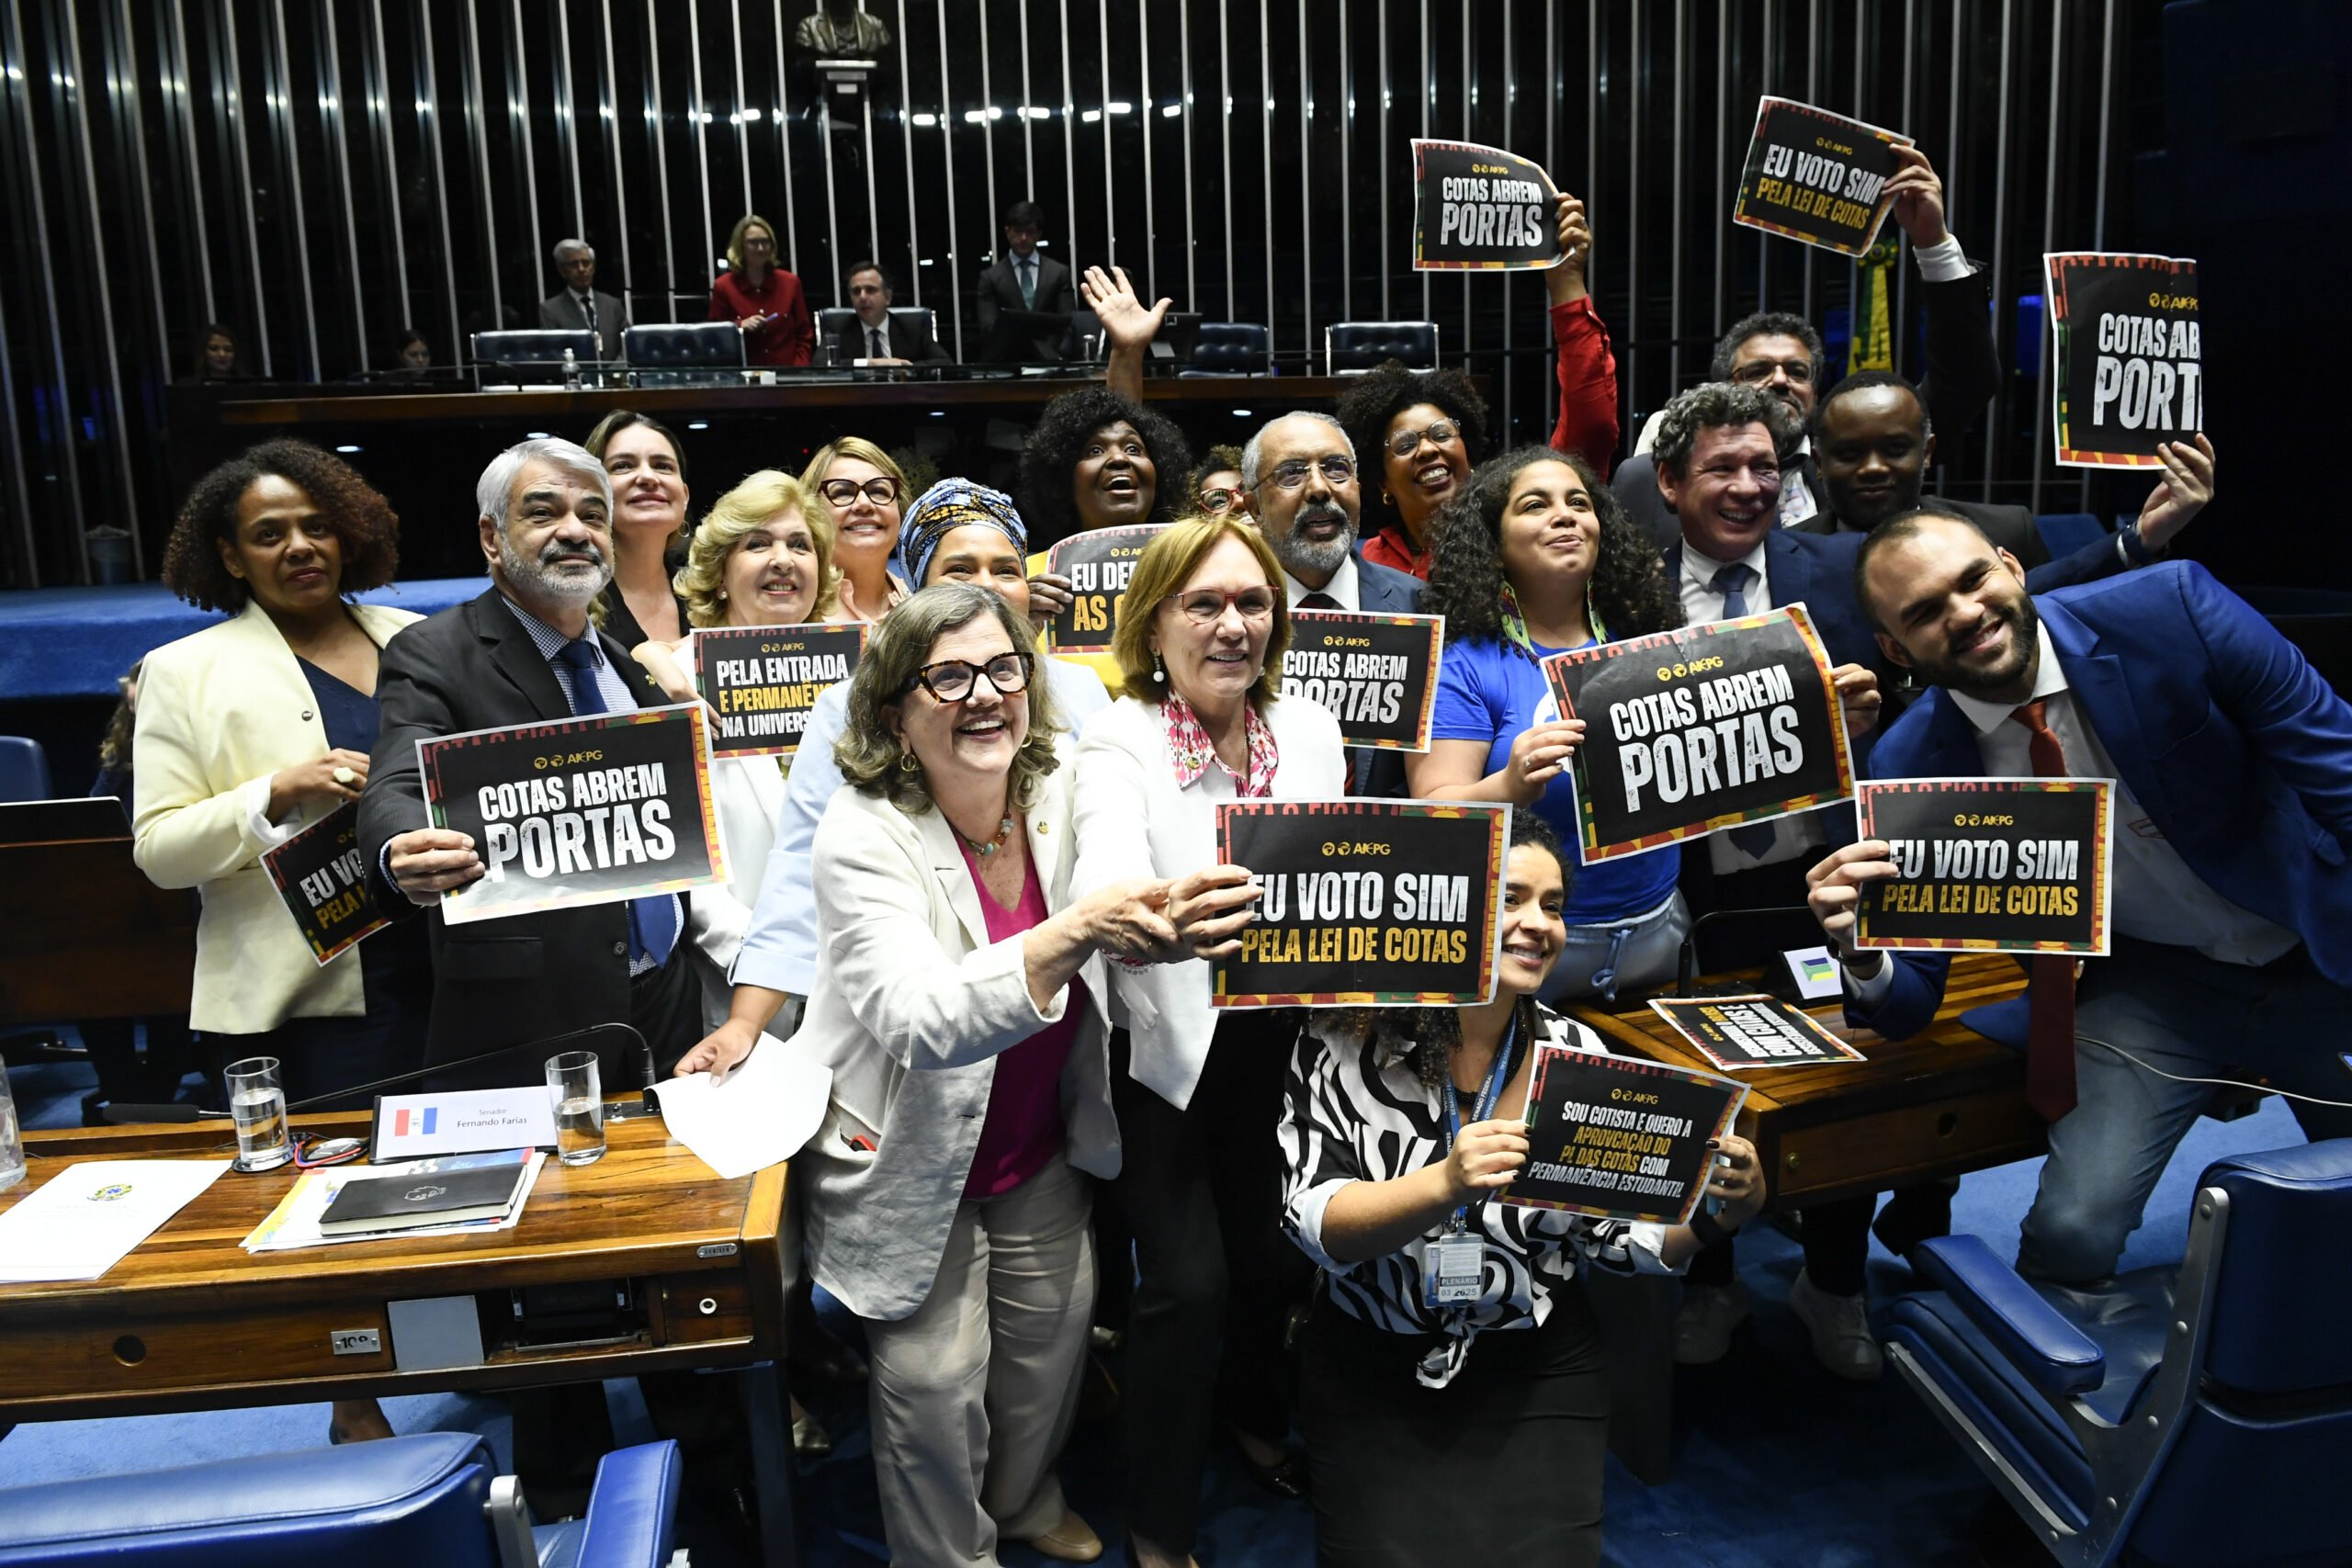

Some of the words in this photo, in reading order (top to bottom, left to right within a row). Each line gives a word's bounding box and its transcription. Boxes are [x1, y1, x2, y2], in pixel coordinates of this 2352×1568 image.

[1442, 176, 1488, 202] COTAS
[1492, 178, 1544, 203] ABREM
[1762, 144, 1793, 178] EU
[1794, 151, 1846, 193] VOTO
[1844, 168, 1886, 205] SIM
[1756, 177, 1792, 207] PELA
[1792, 186, 1815, 213] LEI
[1813, 192, 1834, 219] DE
[1831, 199, 1871, 230] COTAS
[1440, 203, 1544, 247] PORTAS
[2098, 312, 2166, 357] COTAS
[2093, 355, 2203, 431] PORT
[1071, 562, 1097, 592] EU
[1073, 594, 1108, 632] AS
[716, 658, 763, 687] PELA
[765, 653, 849, 683] ENTRADA
[1283, 650, 1340, 678] COTAS
[1343, 653, 1408, 681] ABREM
[718, 690, 729, 713] E
[1609, 687, 1697, 742] COTAS
[1699, 664, 1794, 720] ABREM
[721, 716, 745, 738] NA
[1618, 705, 1804, 813] PORTAS
[478, 776, 567, 821] COTAS
[571, 761, 667, 808] ABREM
[484, 798, 676, 883] PORTAS
[1889, 840, 1926, 879] EU
[1933, 839, 2009, 880] VOTO
[2016, 840, 2079, 880] SIM
[300, 867, 336, 908] EU
[1296, 871, 1384, 920] VOTO
[1393, 873, 1469, 922] SIM
[1882, 885, 1934, 913] PELA
[1939, 885, 1970, 913] LEI
[1974, 885, 2003, 914] DE
[2007, 886, 2078, 916] COTAS
[315, 891, 361, 930] PELA
[1241, 928, 1302, 963] PELA
[1307, 927, 1342, 963] LEI
[1348, 927, 1377, 962] DE
[1385, 927, 1467, 964] COTAS
[1472, 1096, 1485, 1122] SENADO
[1481, 1074, 1493, 1098] FEDERAL
[457, 1118, 499, 1128] Fernando
[502, 1116, 527, 1125] Farias
[1562, 1100, 1589, 1122] SOU
[1589, 1106, 1637, 1130] COTISTA
[1635, 1112, 1646, 1131] E
[1645, 1113, 1683, 1137] QUERO
[1681, 1120, 1693, 1138] A
[1558, 1145, 1574, 1163] PL
[1575, 1146, 1602, 1168] DAS
[1600, 1150, 1640, 1173] COTAS
[1639, 1156, 1670, 1177] COM
[1652, 1136, 1672, 1156] DO
[1528, 1161, 1617, 1190] PERMANÊNCIA
